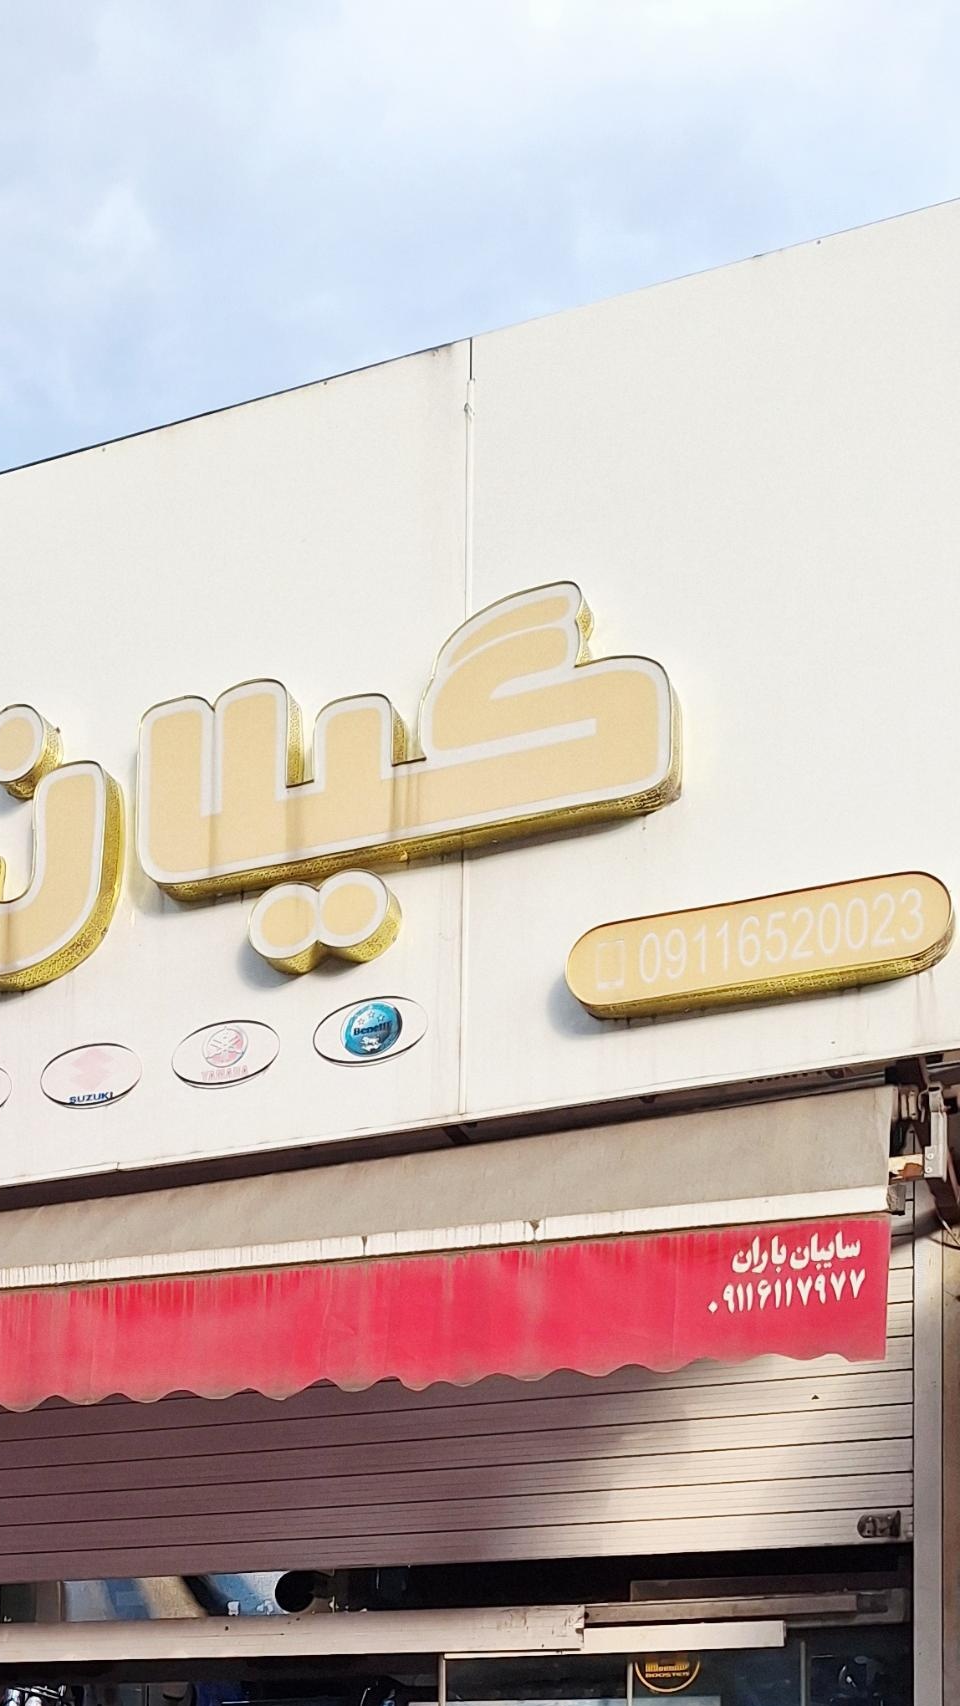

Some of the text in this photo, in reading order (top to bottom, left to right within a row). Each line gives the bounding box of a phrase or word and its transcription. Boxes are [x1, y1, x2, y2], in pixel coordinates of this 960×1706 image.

[639, 887, 925, 984] 09116520023
[69, 1091, 113, 1104] SUZUKI
[731, 1231, 861, 1274] سایبان باران
[707, 1268, 866, 1314] ۰۹۱۱۶۱۱۷۹۷۷
